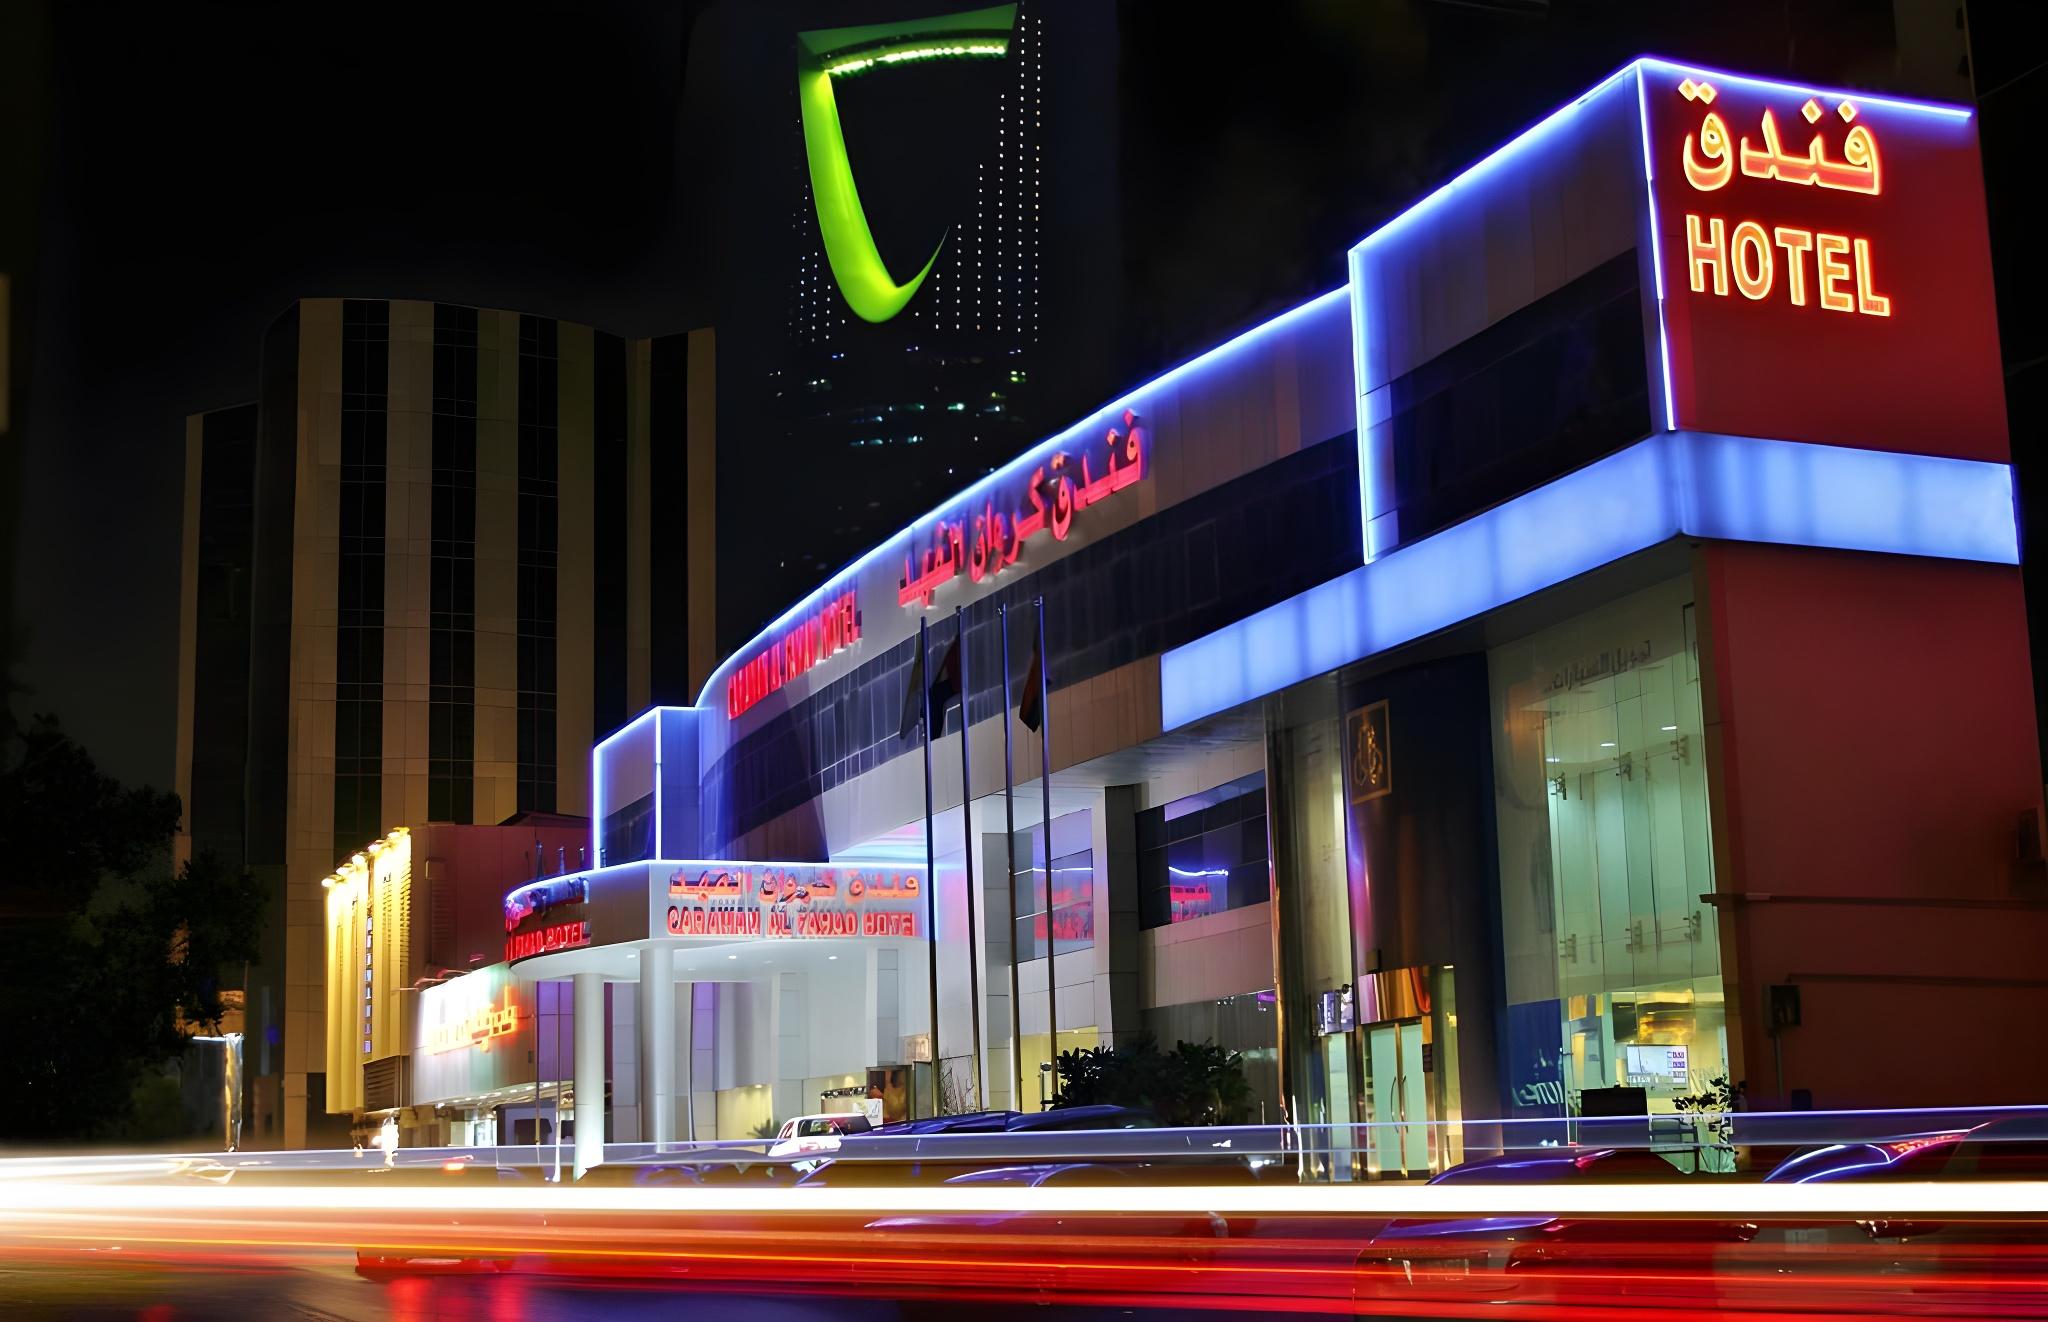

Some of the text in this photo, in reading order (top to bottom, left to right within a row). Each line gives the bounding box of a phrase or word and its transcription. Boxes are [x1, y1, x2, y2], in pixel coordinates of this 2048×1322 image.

[1678, 78, 1881, 196] فندق
[1686, 214, 1890, 316] HOTEL
[1052, 408, 1147, 541] فندق
